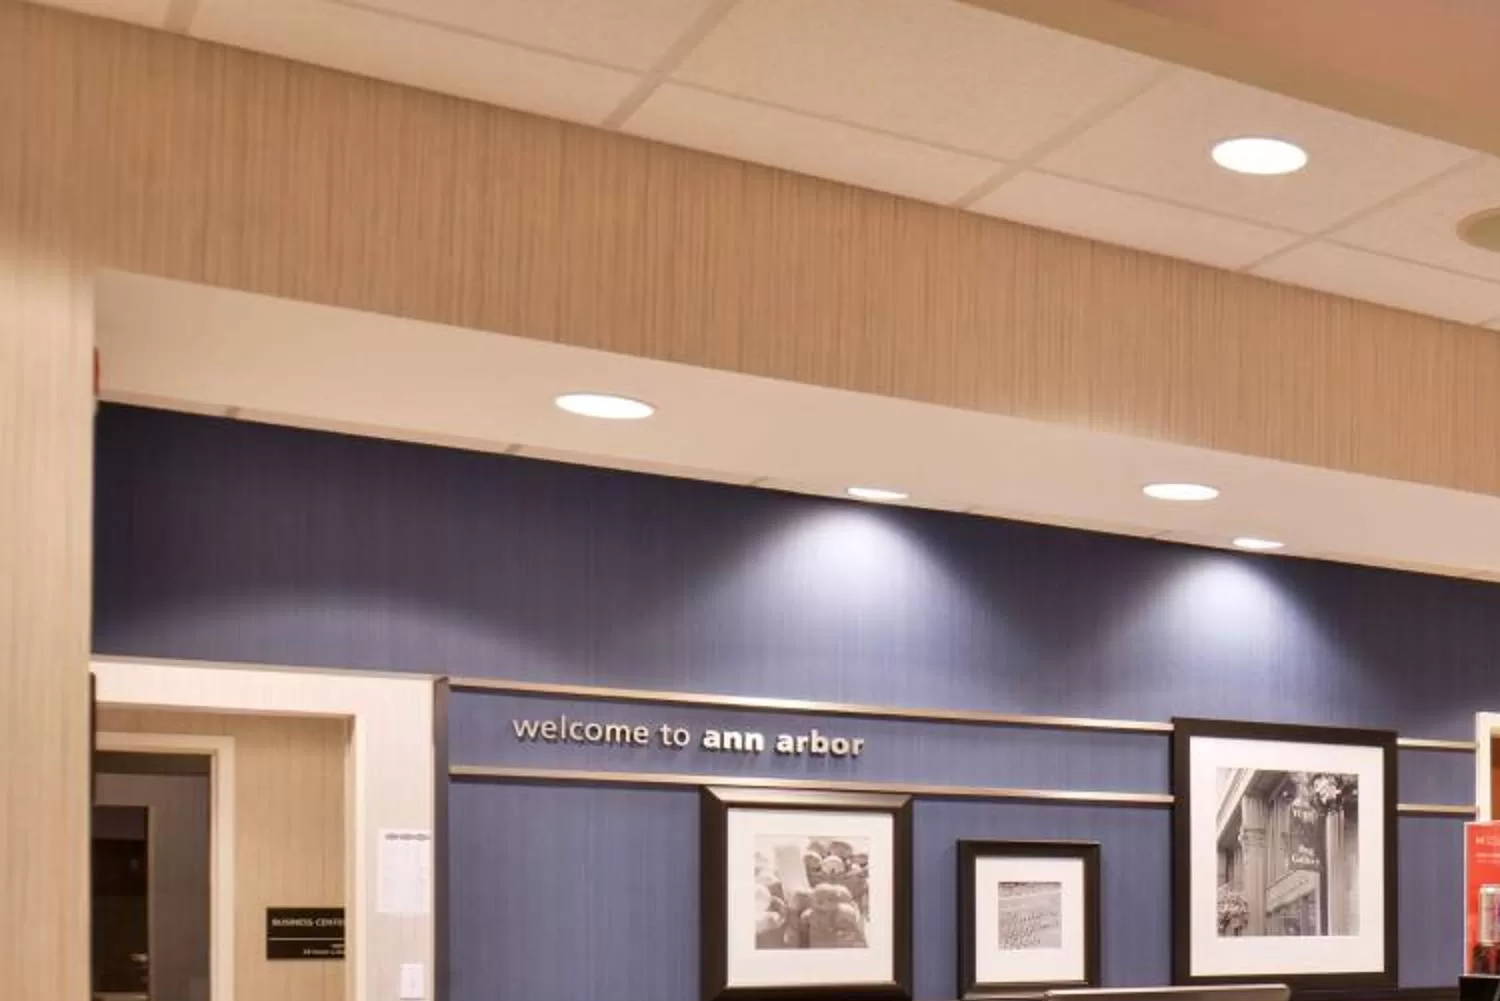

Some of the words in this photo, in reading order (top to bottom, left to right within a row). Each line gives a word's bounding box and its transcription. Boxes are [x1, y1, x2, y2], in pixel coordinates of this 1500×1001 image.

[512, 715, 649, 744] welcome
[661, 723, 690, 746] to
[702, 727, 764, 752] ann
[776, 728, 865, 757] arbor
[315, 918, 345, 928] CENTE
